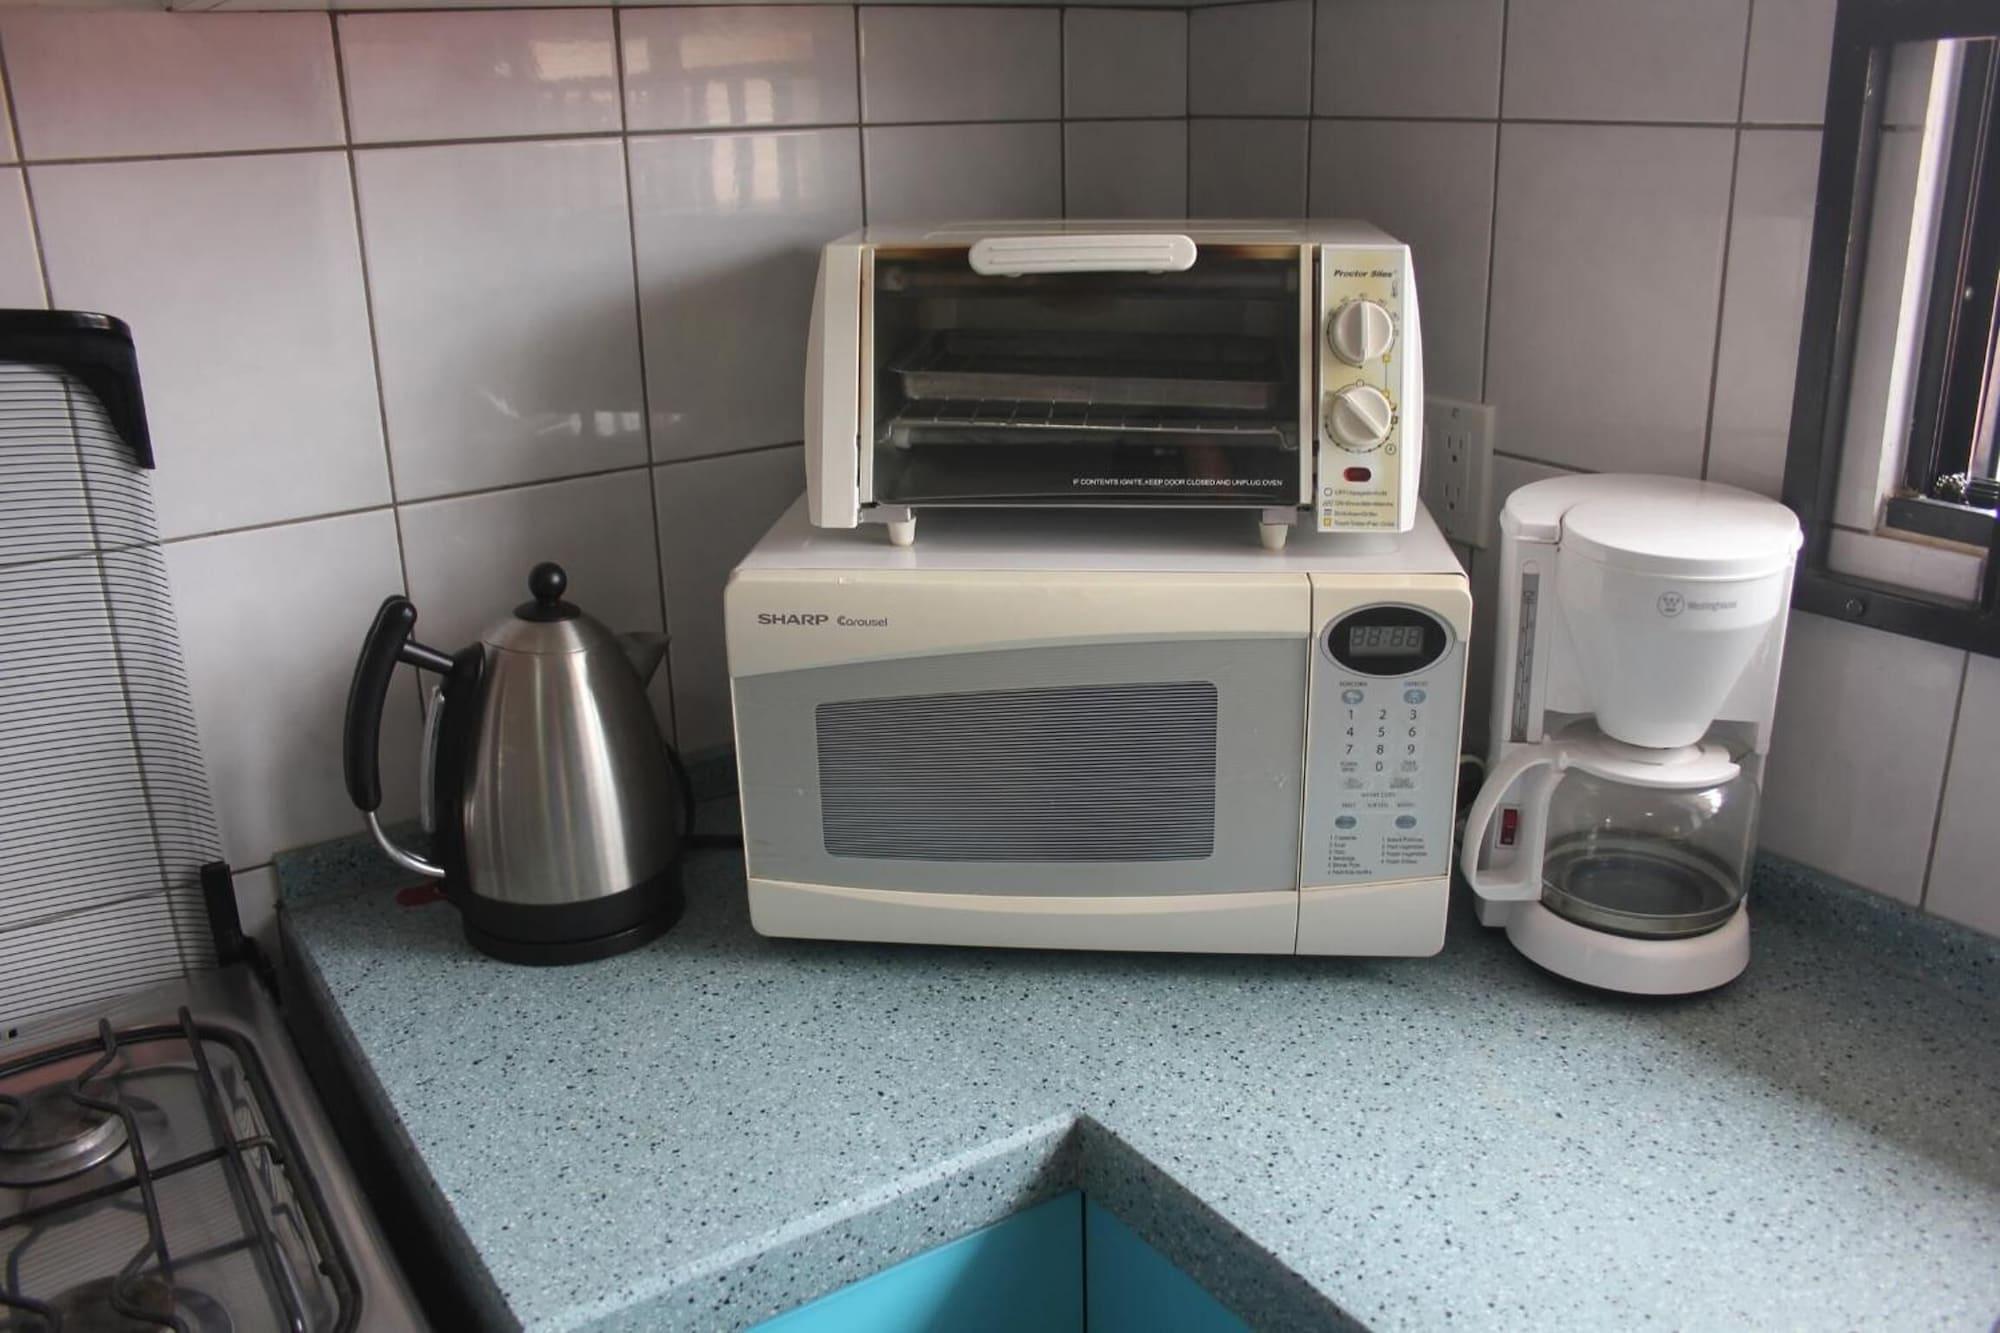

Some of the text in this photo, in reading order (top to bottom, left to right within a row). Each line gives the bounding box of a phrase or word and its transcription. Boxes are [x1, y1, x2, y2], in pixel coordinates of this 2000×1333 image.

[1080, 478, 1119, 486] CONTENTS
[1164, 478, 1186, 487] DOOR
[1187, 478, 1216, 487] CLOSED
[1216, 479, 1231, 487] AND
[1231, 479, 1261, 487] UNPLUG
[1262, 479, 1283, 487] OVEN
[758, 613, 888, 627] SHARP Carousel
[1349, 709, 1354, 720] 1
[1379, 709, 1387, 720] 2
[1410, 709, 1417, 720] 3
[1346, 727, 1354, 737] 4
[1378, 726, 1385, 738] 5
[1408, 726, 1417, 738] 6
[1346, 744, 1354, 755] 7
[1376, 744, 1384, 755] 8
[1407, 744, 1415, 756] 9
[1375, 761, 1383, 772] 0
